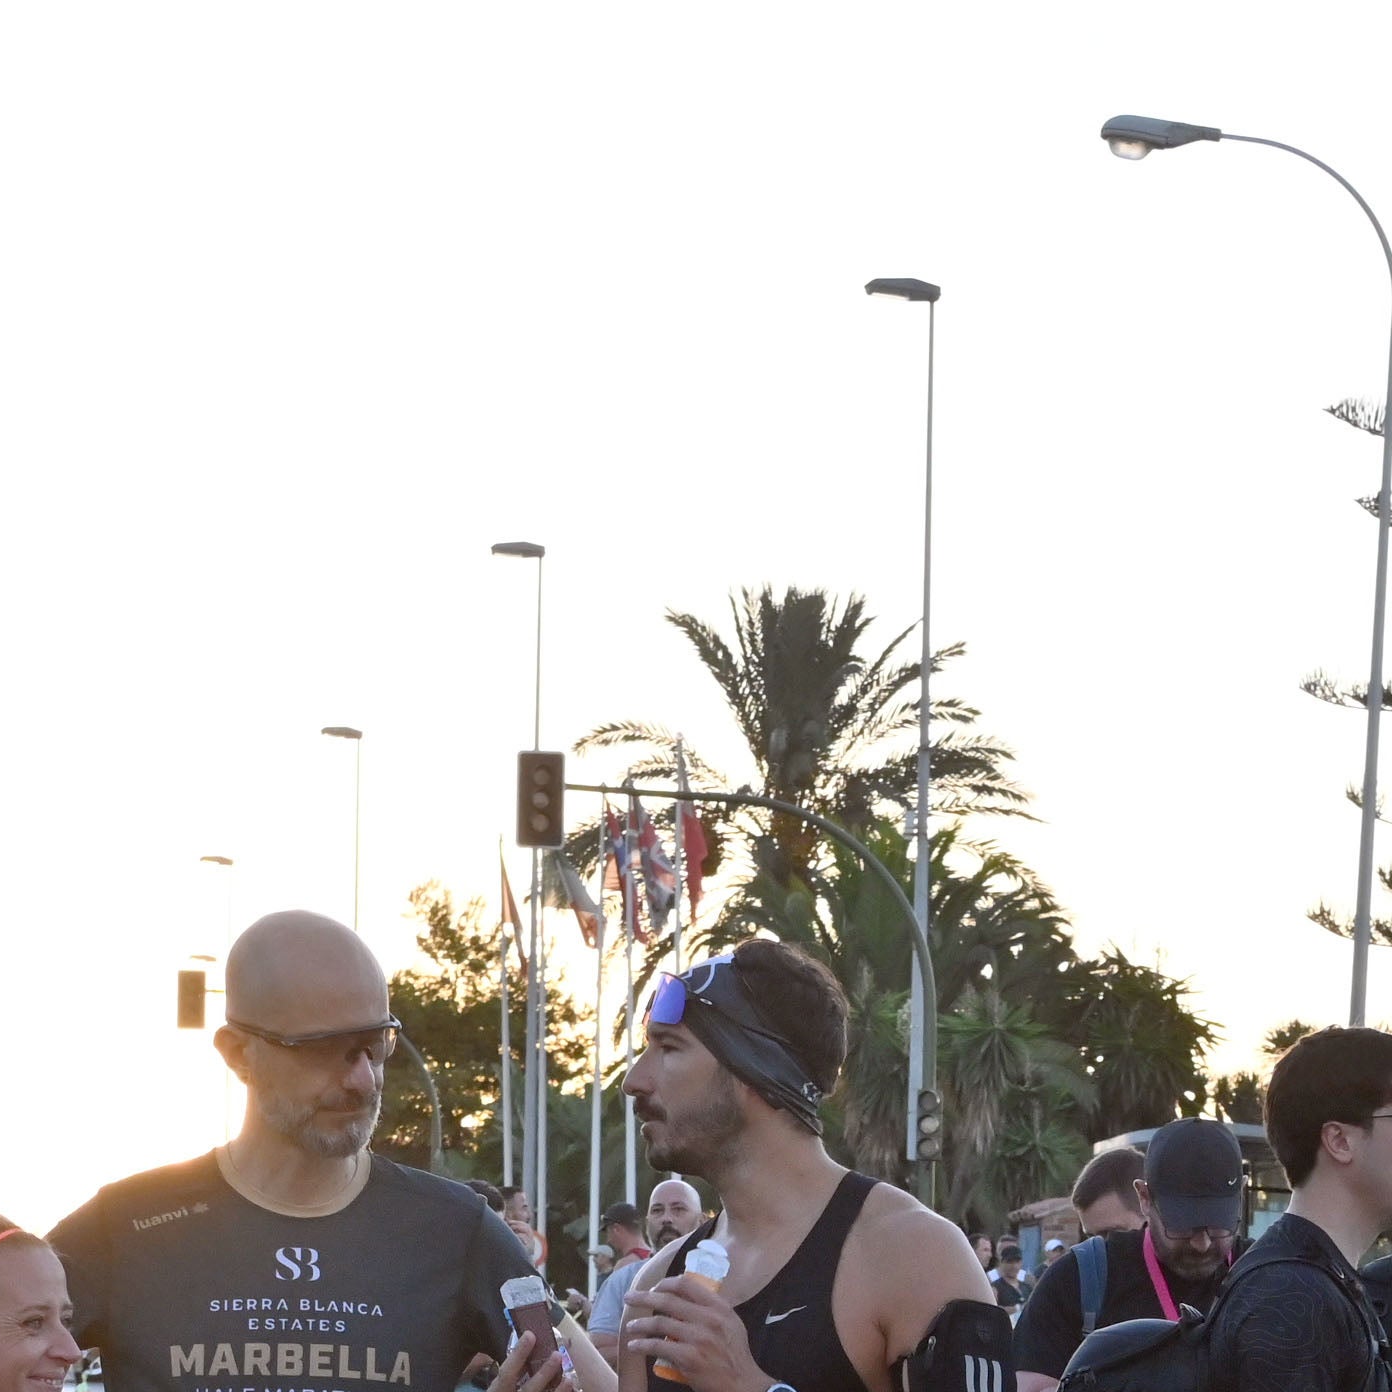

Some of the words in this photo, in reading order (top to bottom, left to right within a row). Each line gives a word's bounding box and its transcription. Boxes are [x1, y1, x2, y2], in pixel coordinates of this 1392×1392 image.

[209, 1297, 289, 1312] SIERRA
[299, 1298, 384, 1317] BLANCA
[248, 1318, 346, 1333] ESTATES
[169, 1342, 411, 1386] MARBELLA
